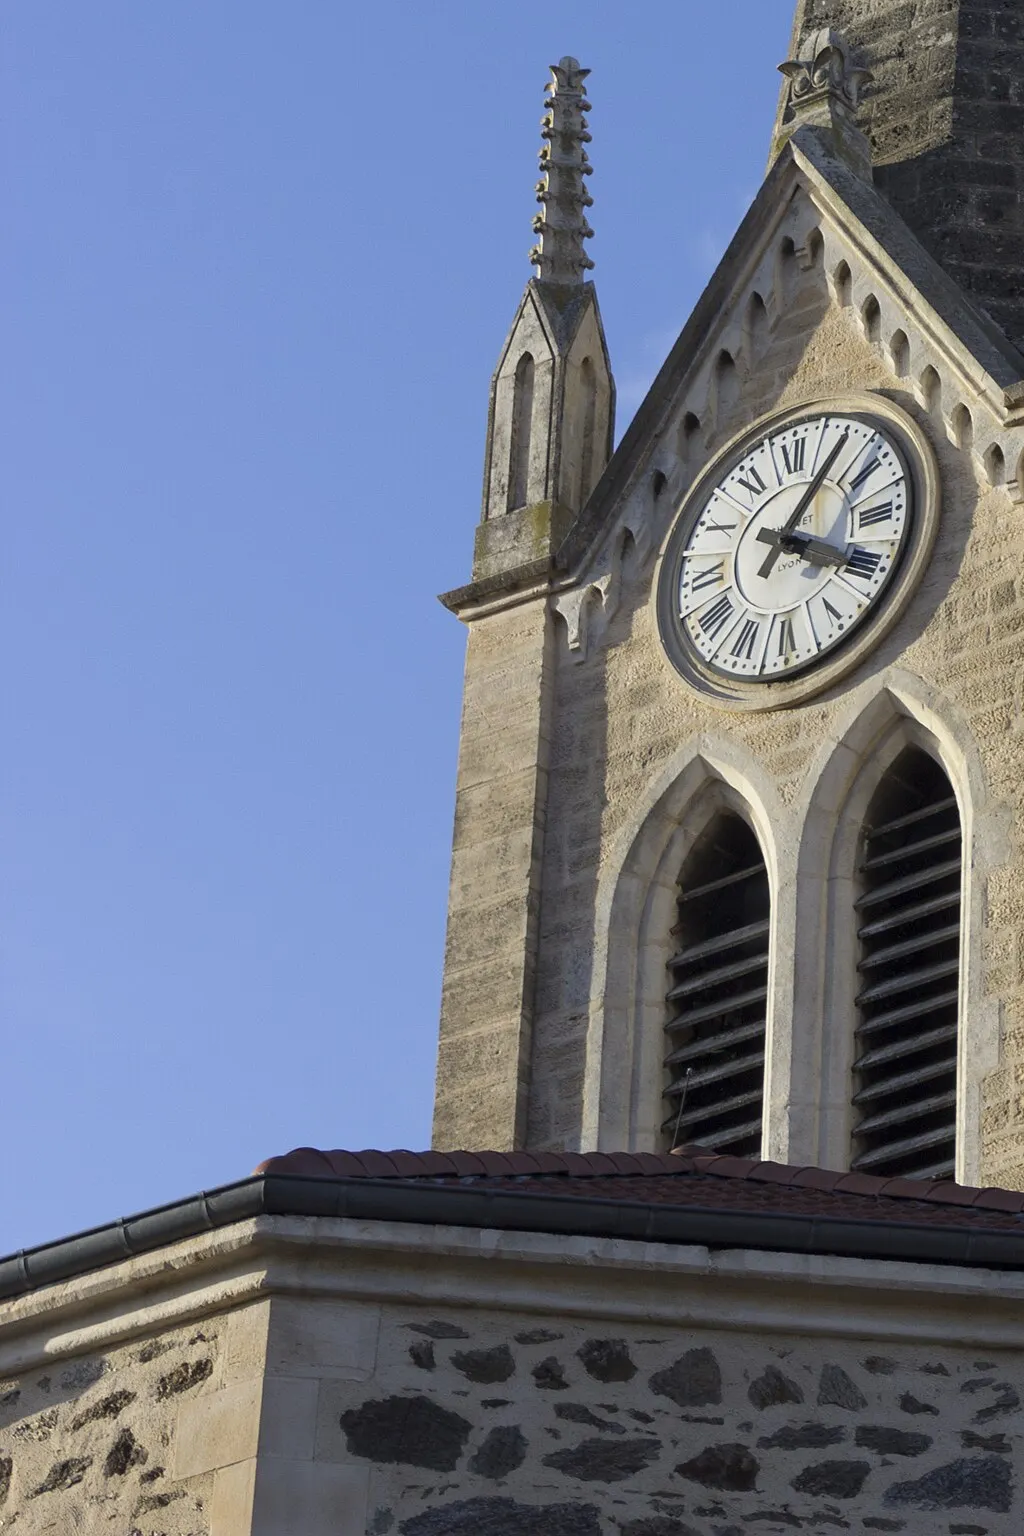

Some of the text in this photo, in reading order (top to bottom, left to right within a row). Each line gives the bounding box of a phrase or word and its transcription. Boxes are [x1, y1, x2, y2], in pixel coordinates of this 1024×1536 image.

[781, 437, 807, 474] XII
[737, 466, 768, 504] XI
[849, 457, 883, 491] II
[705, 518, 737, 539] X
[858, 500, 893, 529] III
[692, 560, 725, 594] IX
[778, 558, 802, 572] LYON
[698, 595, 735, 641] VIII
[821, 597, 843, 627] V
[730, 619, 760, 660] VII
[778, 618, 796, 656] VI
